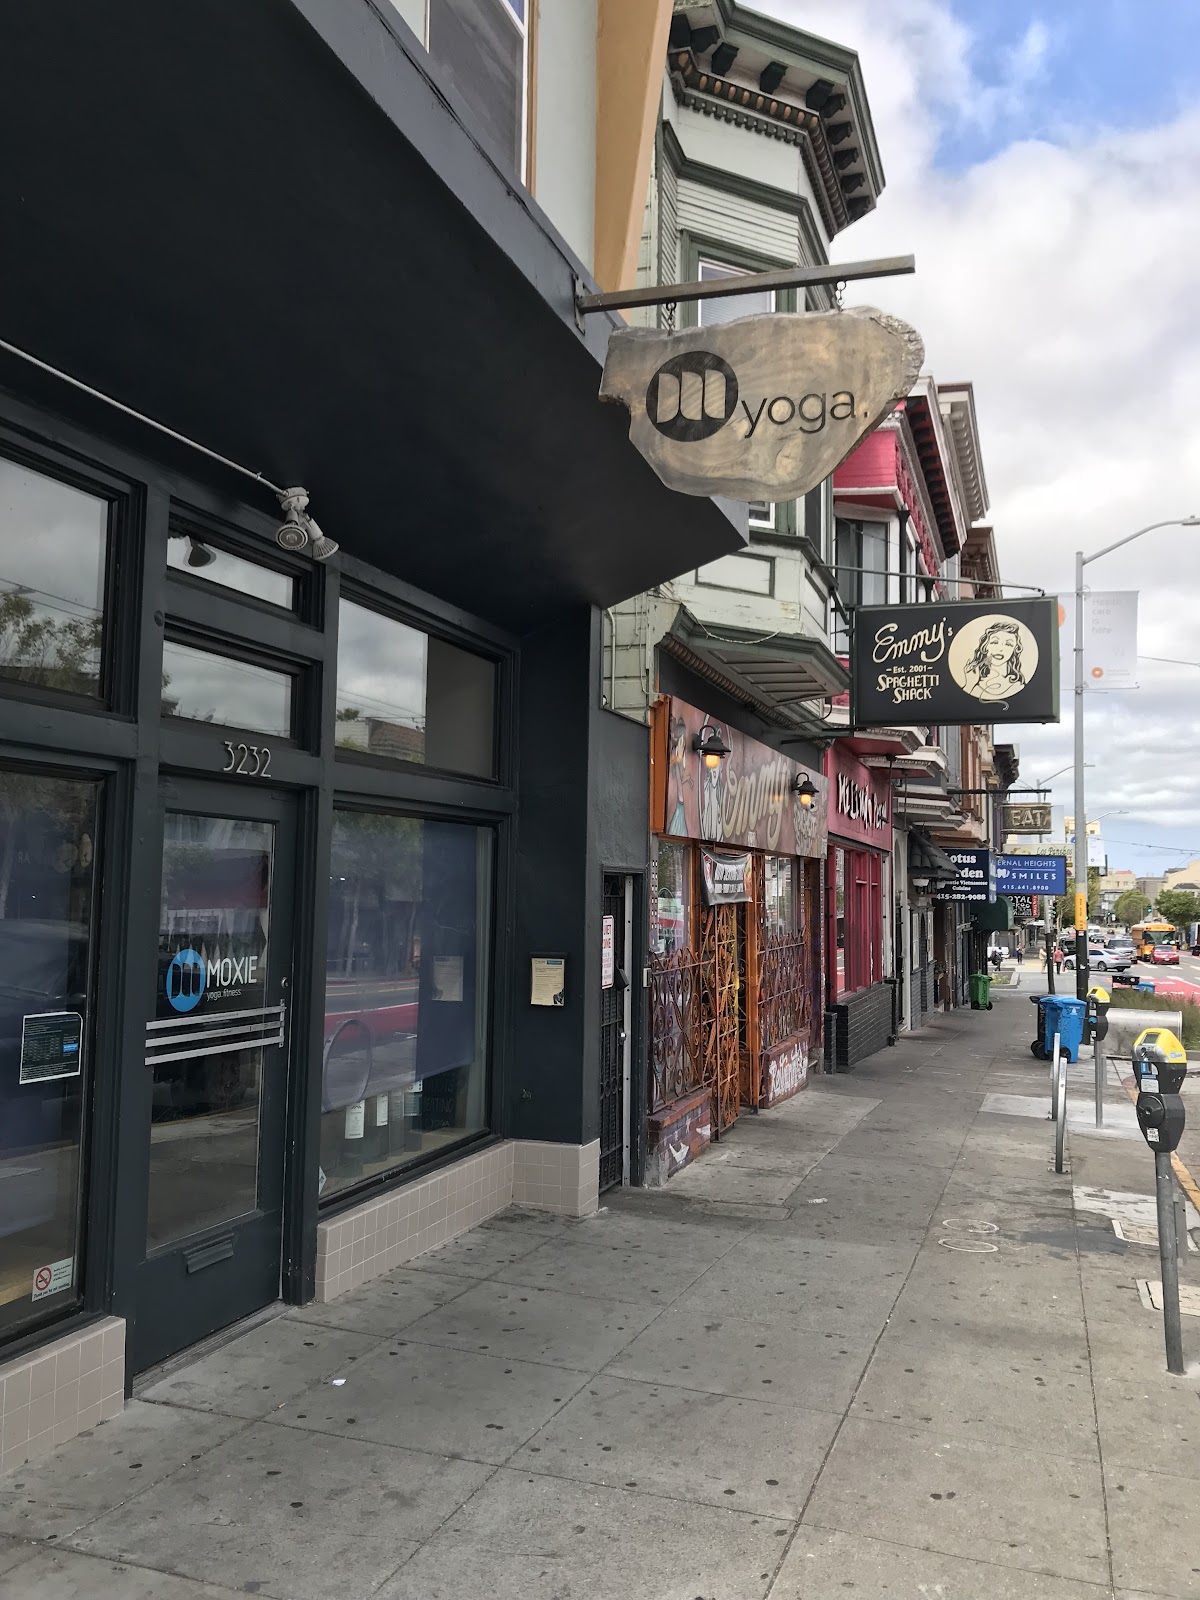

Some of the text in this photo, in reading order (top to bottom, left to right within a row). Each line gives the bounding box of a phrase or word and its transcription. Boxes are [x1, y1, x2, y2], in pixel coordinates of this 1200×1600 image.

[873, 616, 953, 663] Emmy's
[876, 674, 939, 691] SPAGHETTI
[892, 687, 932, 704] SHACK
[223, 740, 272, 777] 3232
[1010, 809, 1044, 826] EAT
[945, 853, 977, 864] otus
[206, 955, 258, 988] MOXIE
